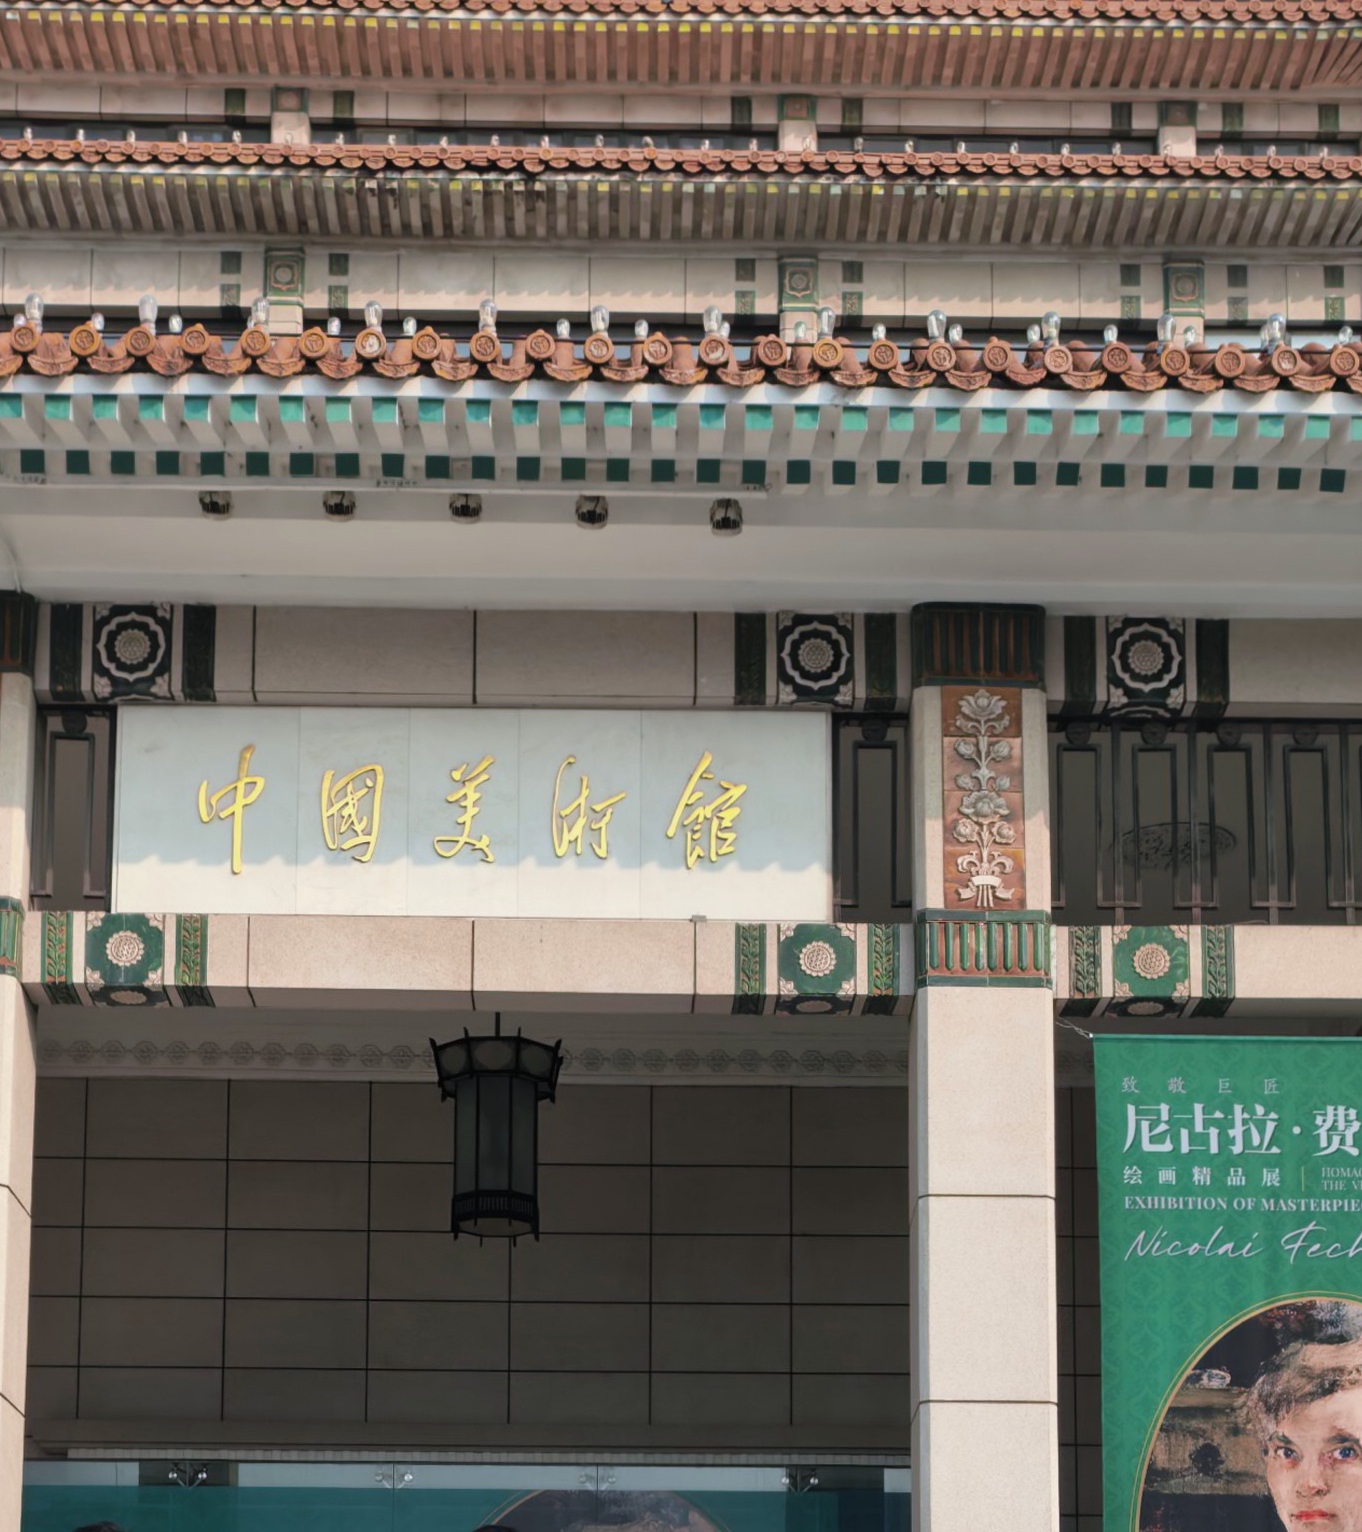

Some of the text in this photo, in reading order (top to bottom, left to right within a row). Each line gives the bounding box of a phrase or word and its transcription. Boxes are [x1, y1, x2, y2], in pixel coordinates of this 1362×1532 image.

[198, 744, 747, 875] 中國美術館
[1122, 1076, 1279, 1094] 致敬巨匠
[1123, 1166, 1280, 1186] 绘画精品展
[1322, 1180, 1347, 1191] THE
[1124, 1196, 1228, 1210] EXHIBITION
[1233, 1197, 1256, 1210] OF
[1124, 1225, 1264, 1262] Nicolai
